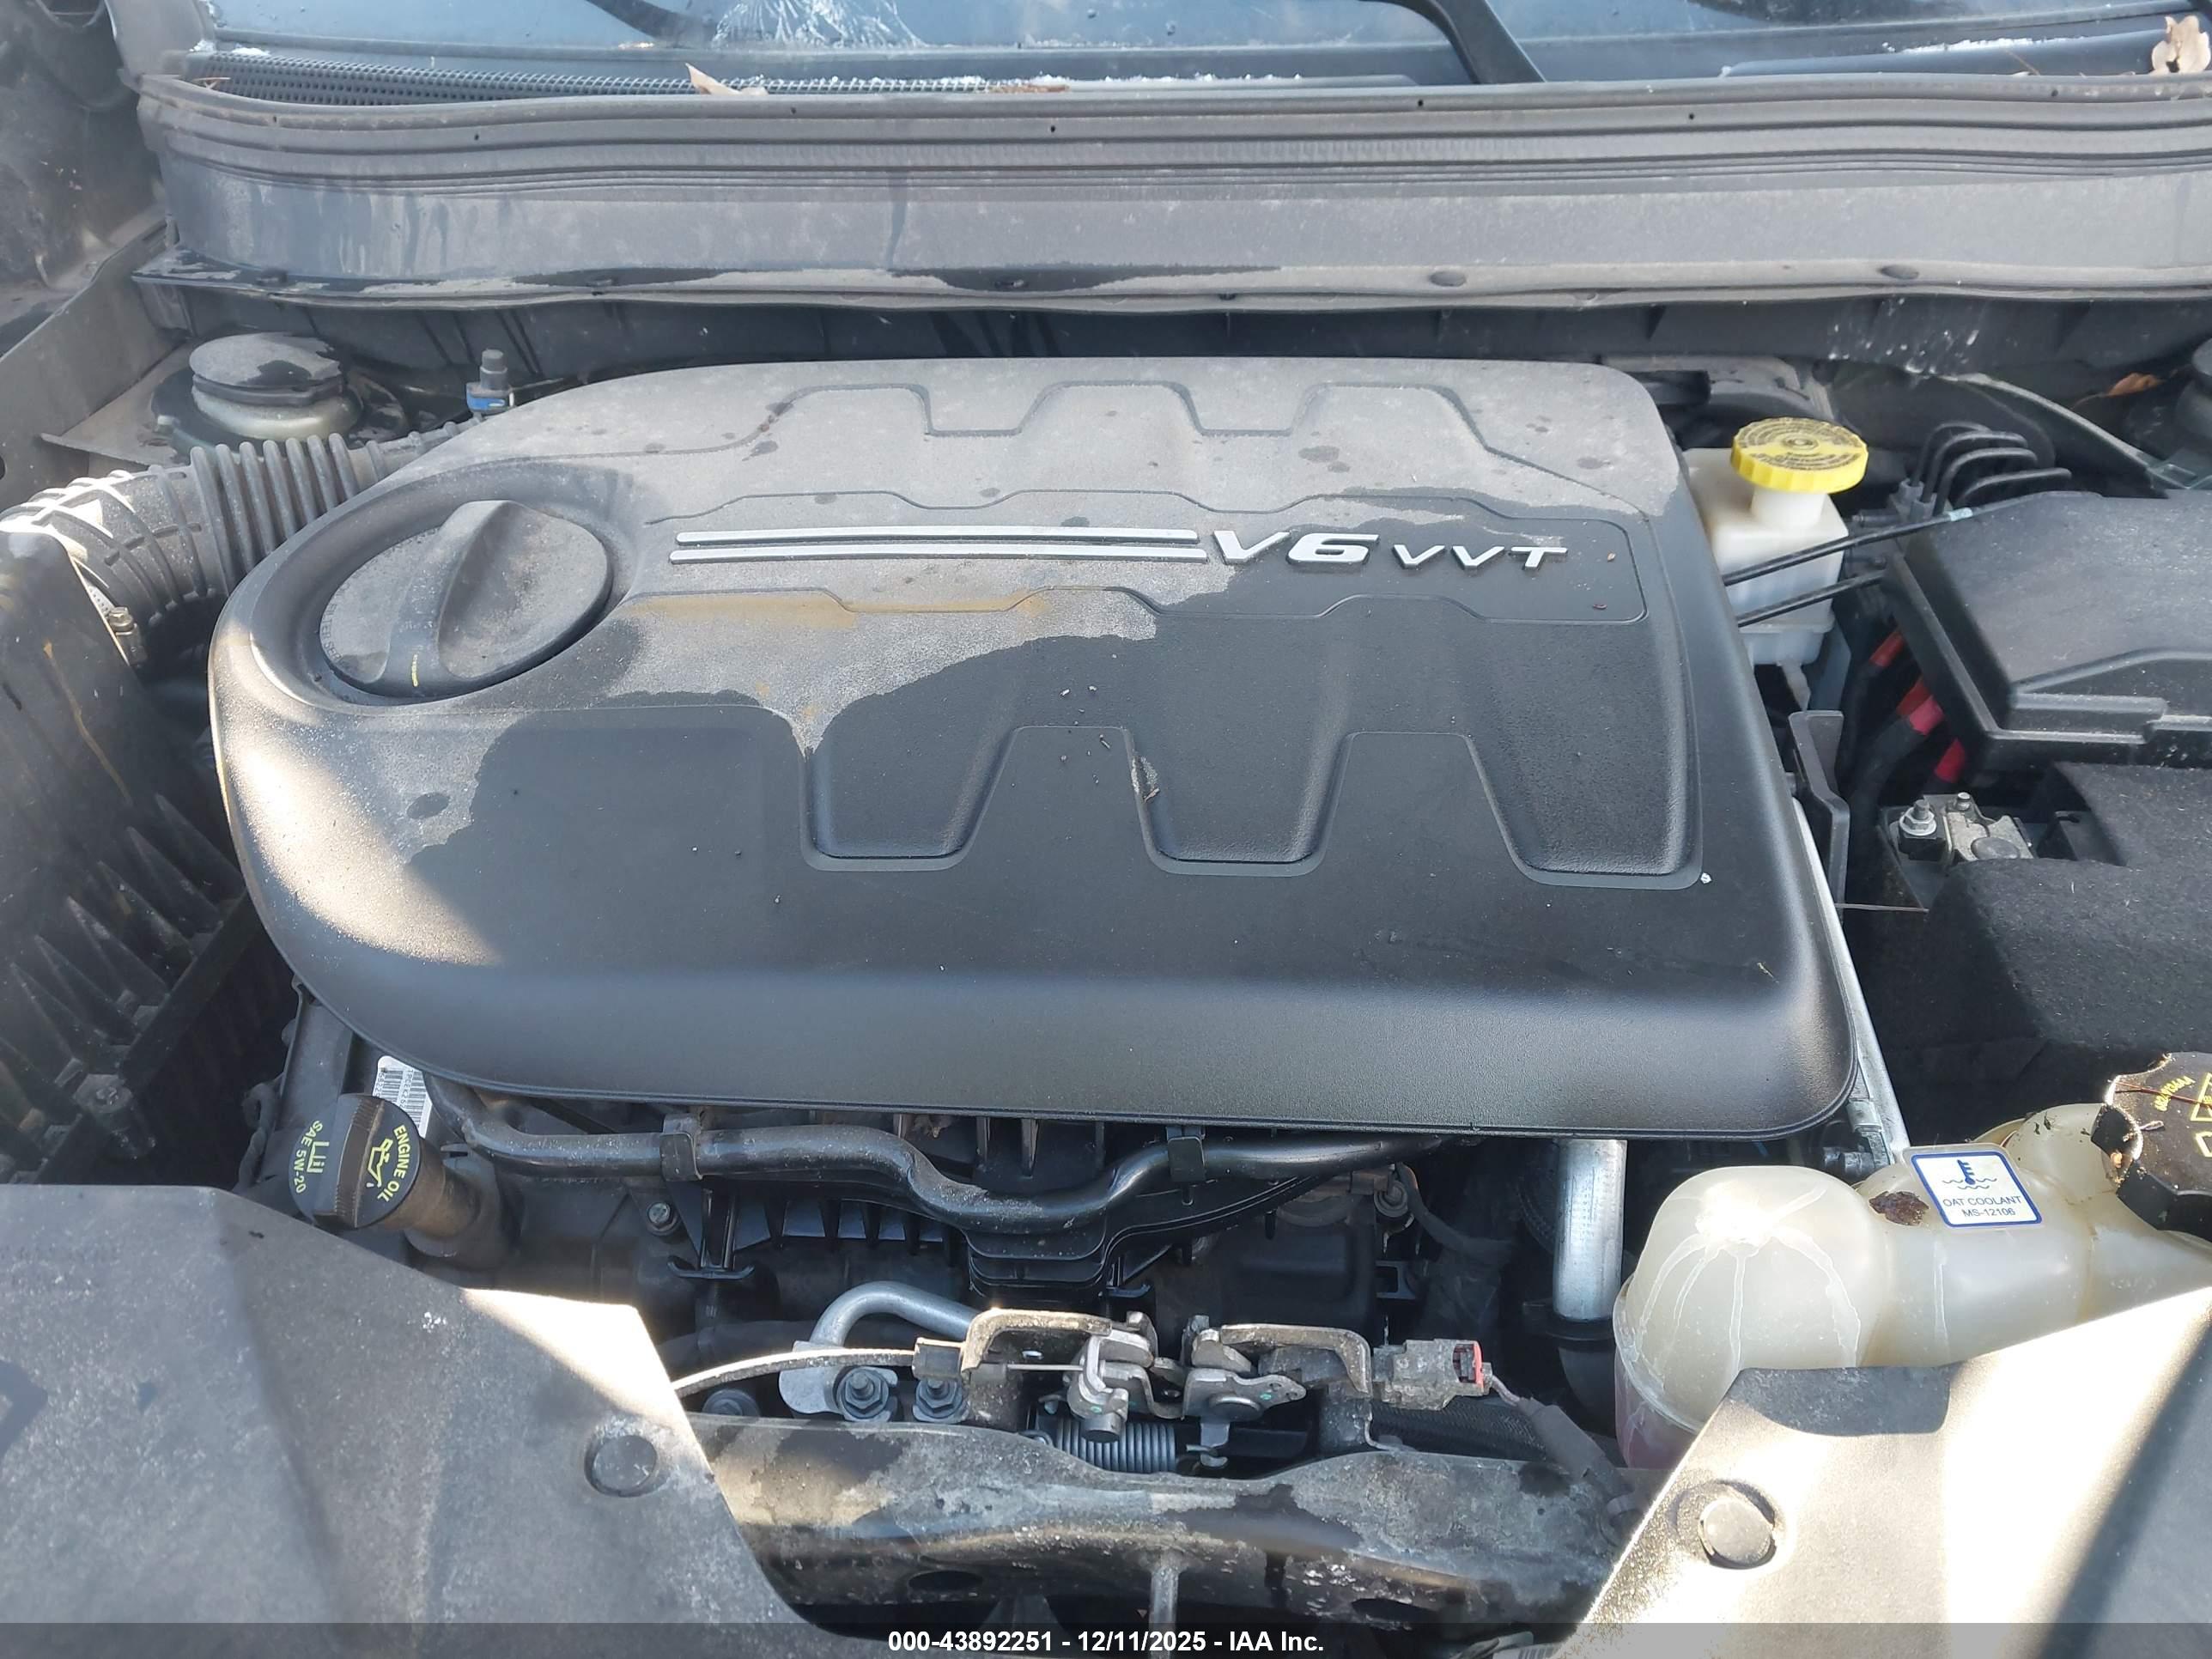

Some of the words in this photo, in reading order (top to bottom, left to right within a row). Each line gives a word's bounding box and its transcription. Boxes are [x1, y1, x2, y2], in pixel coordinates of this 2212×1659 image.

[1212, 530, 1381, 566] V6
[1391, 544, 1569, 571] VVT
[300, 1120, 324, 1147] SAE
[393, 1124, 410, 1179] ENGINE
[293, 1149, 307, 1194] 5W-20
[377, 1182, 400, 1202] OIL
[1942, 1197, 1965, 1207] OAT
[1967, 1195, 2022, 1206] COOLANT
[1962, 1207, 2016, 1217] MS-12106
